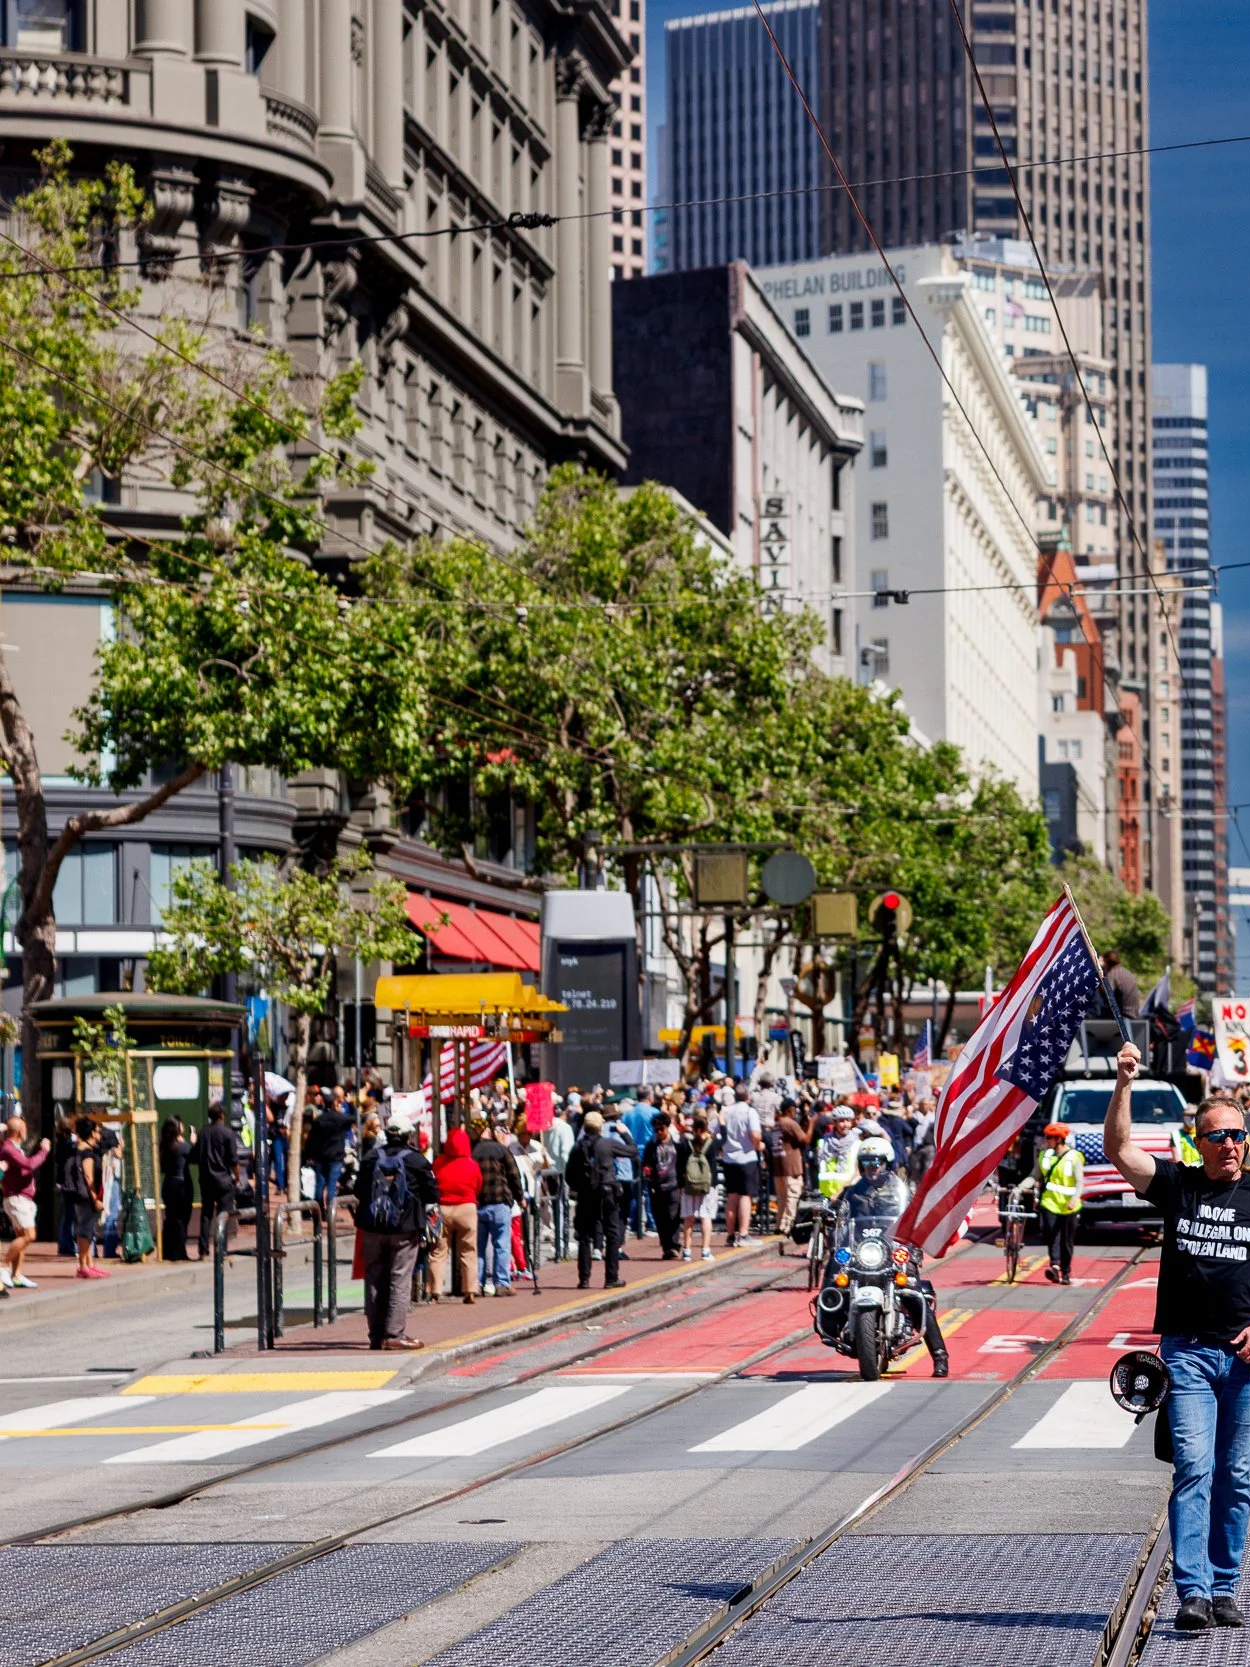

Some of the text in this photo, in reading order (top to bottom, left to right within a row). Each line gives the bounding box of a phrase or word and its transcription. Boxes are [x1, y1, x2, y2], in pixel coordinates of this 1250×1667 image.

[830, 264, 906, 293] BUILDING
[1222, 1004, 1246, 1020] NO
[1196, 1204, 1236, 1222] NO ONE
[862, 1228, 882, 1237] 367
[1176, 1218, 1190, 1234] IS
[1189, 1221, 1232, 1240] ILLEGAL
[1215, 1243, 1248, 1261] LAND
